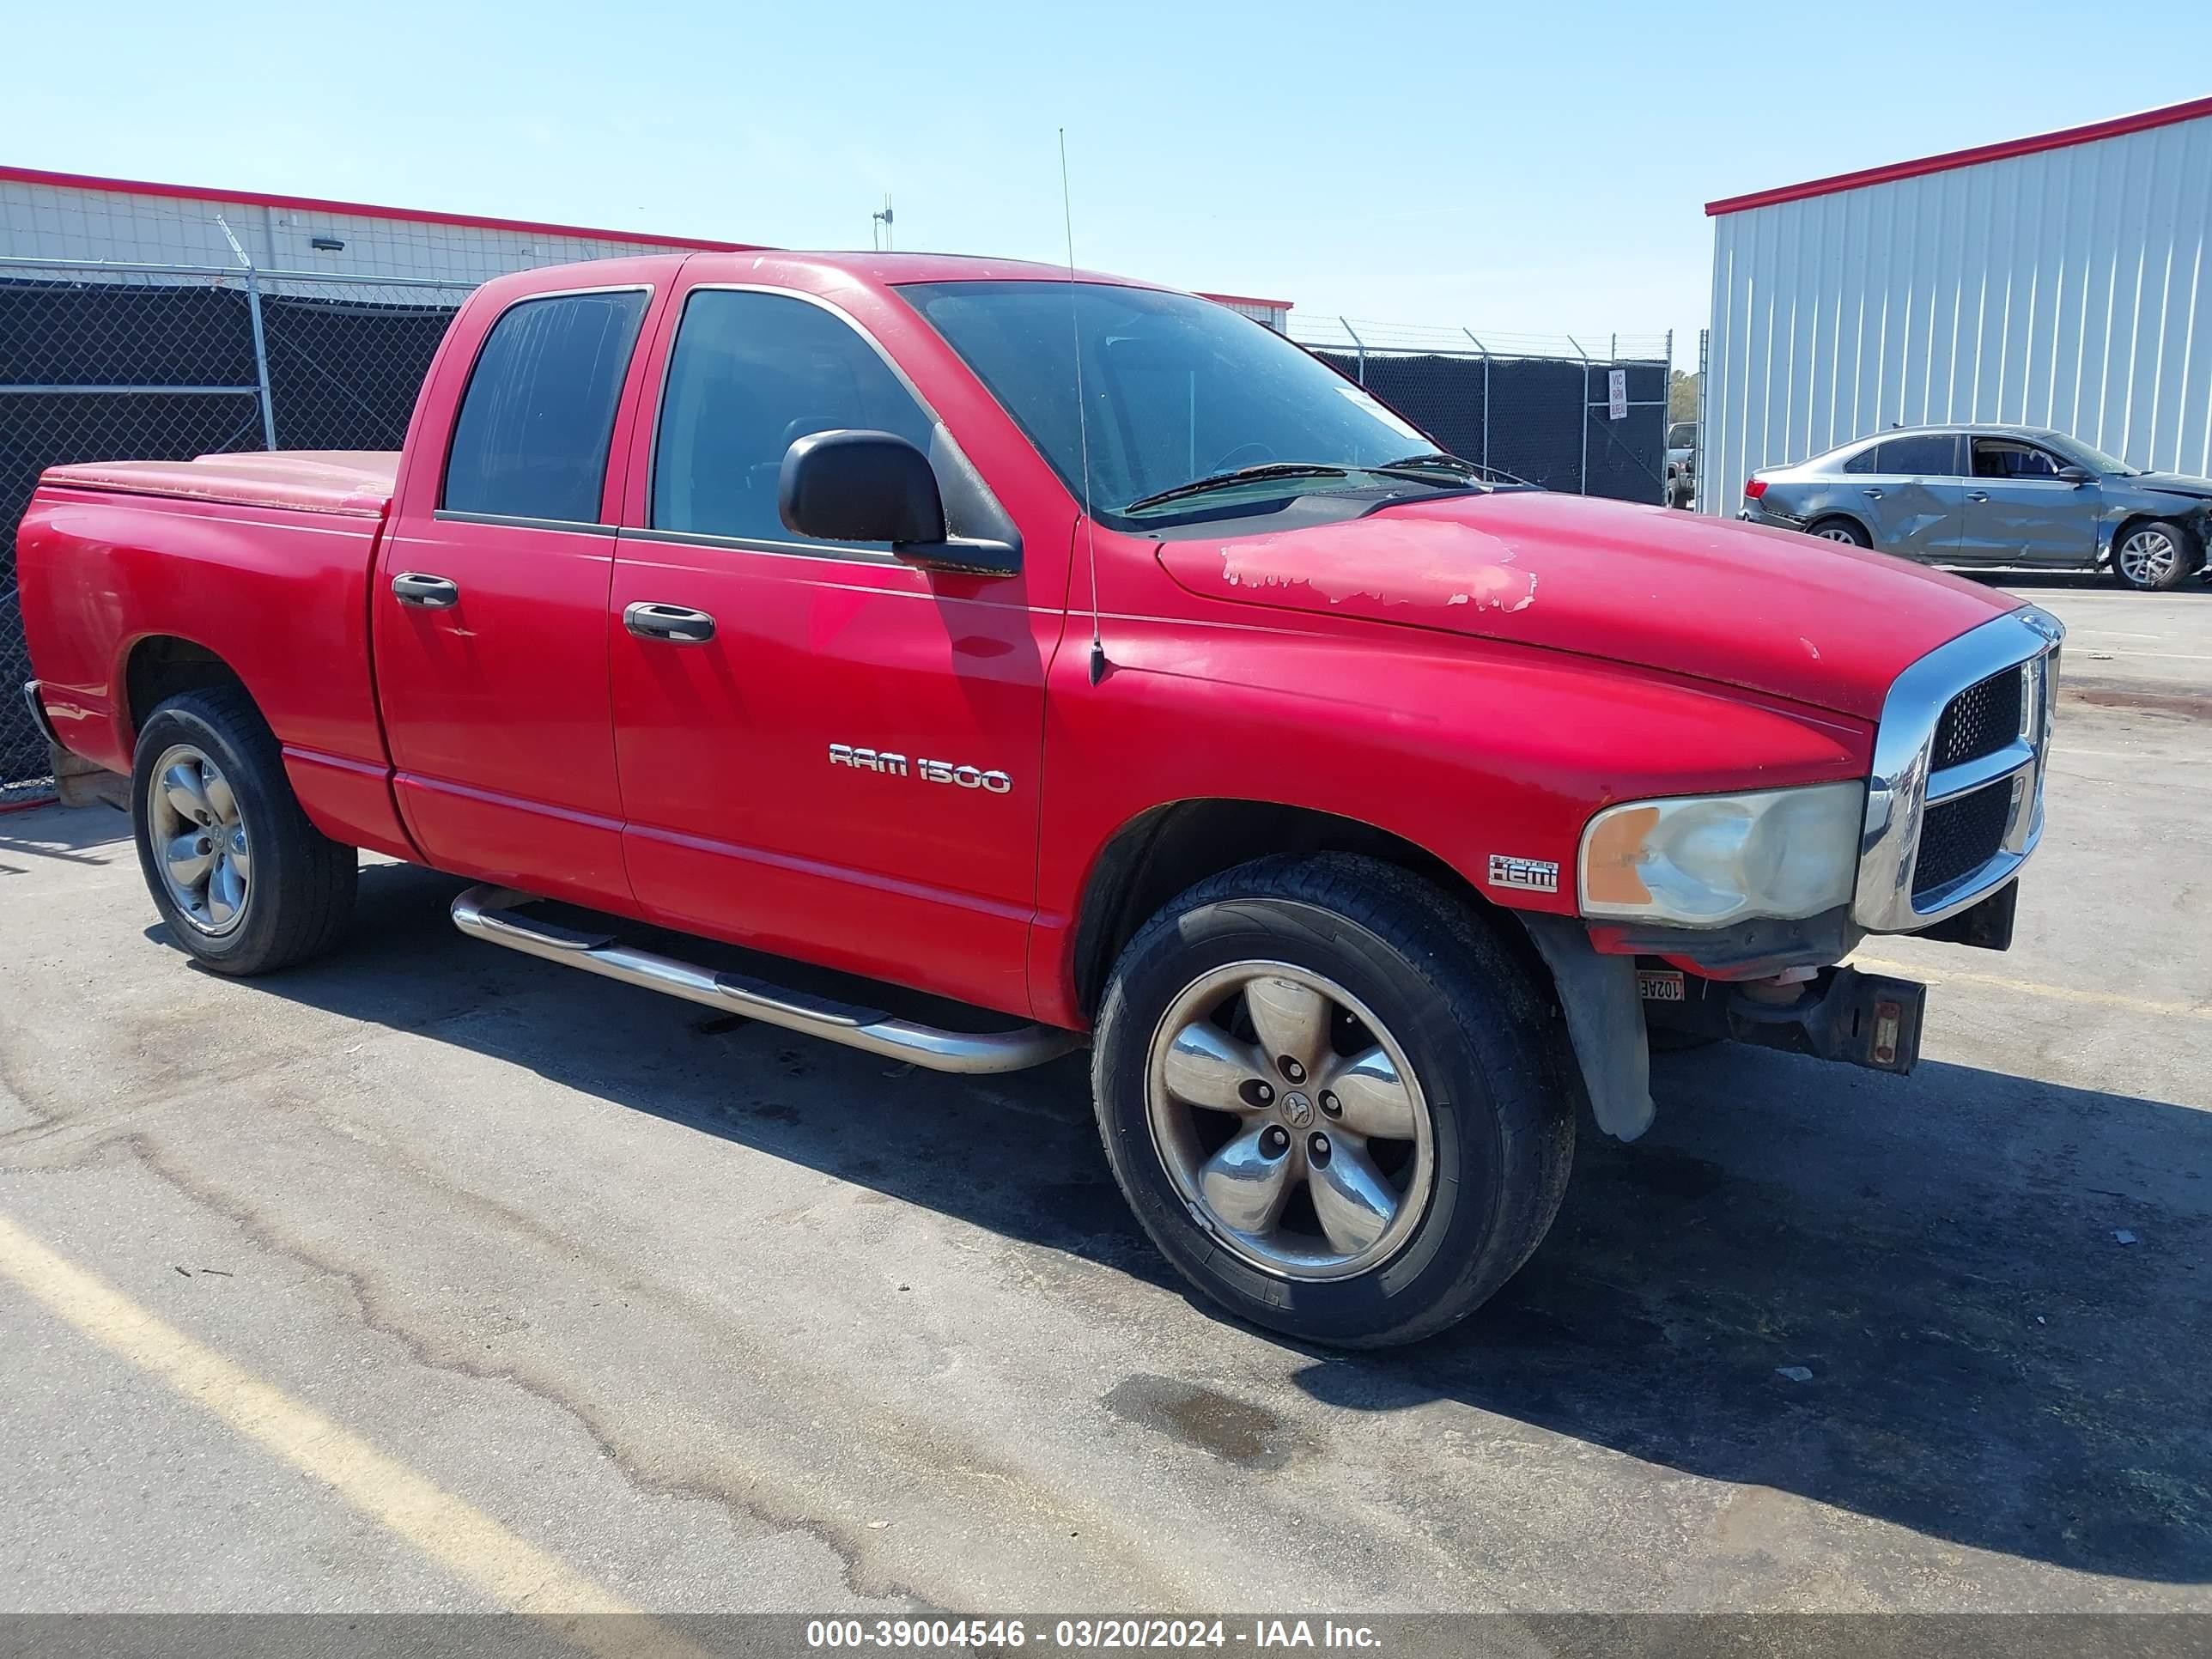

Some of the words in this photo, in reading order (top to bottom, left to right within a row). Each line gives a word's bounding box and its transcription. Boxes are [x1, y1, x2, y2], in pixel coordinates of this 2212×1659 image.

[829, 743, 908, 777] RAM
[917, 758, 1012, 793] 1500
[1490, 862, 1558, 888] HEMI
[1641, 980, 1679, 999] 102AE
